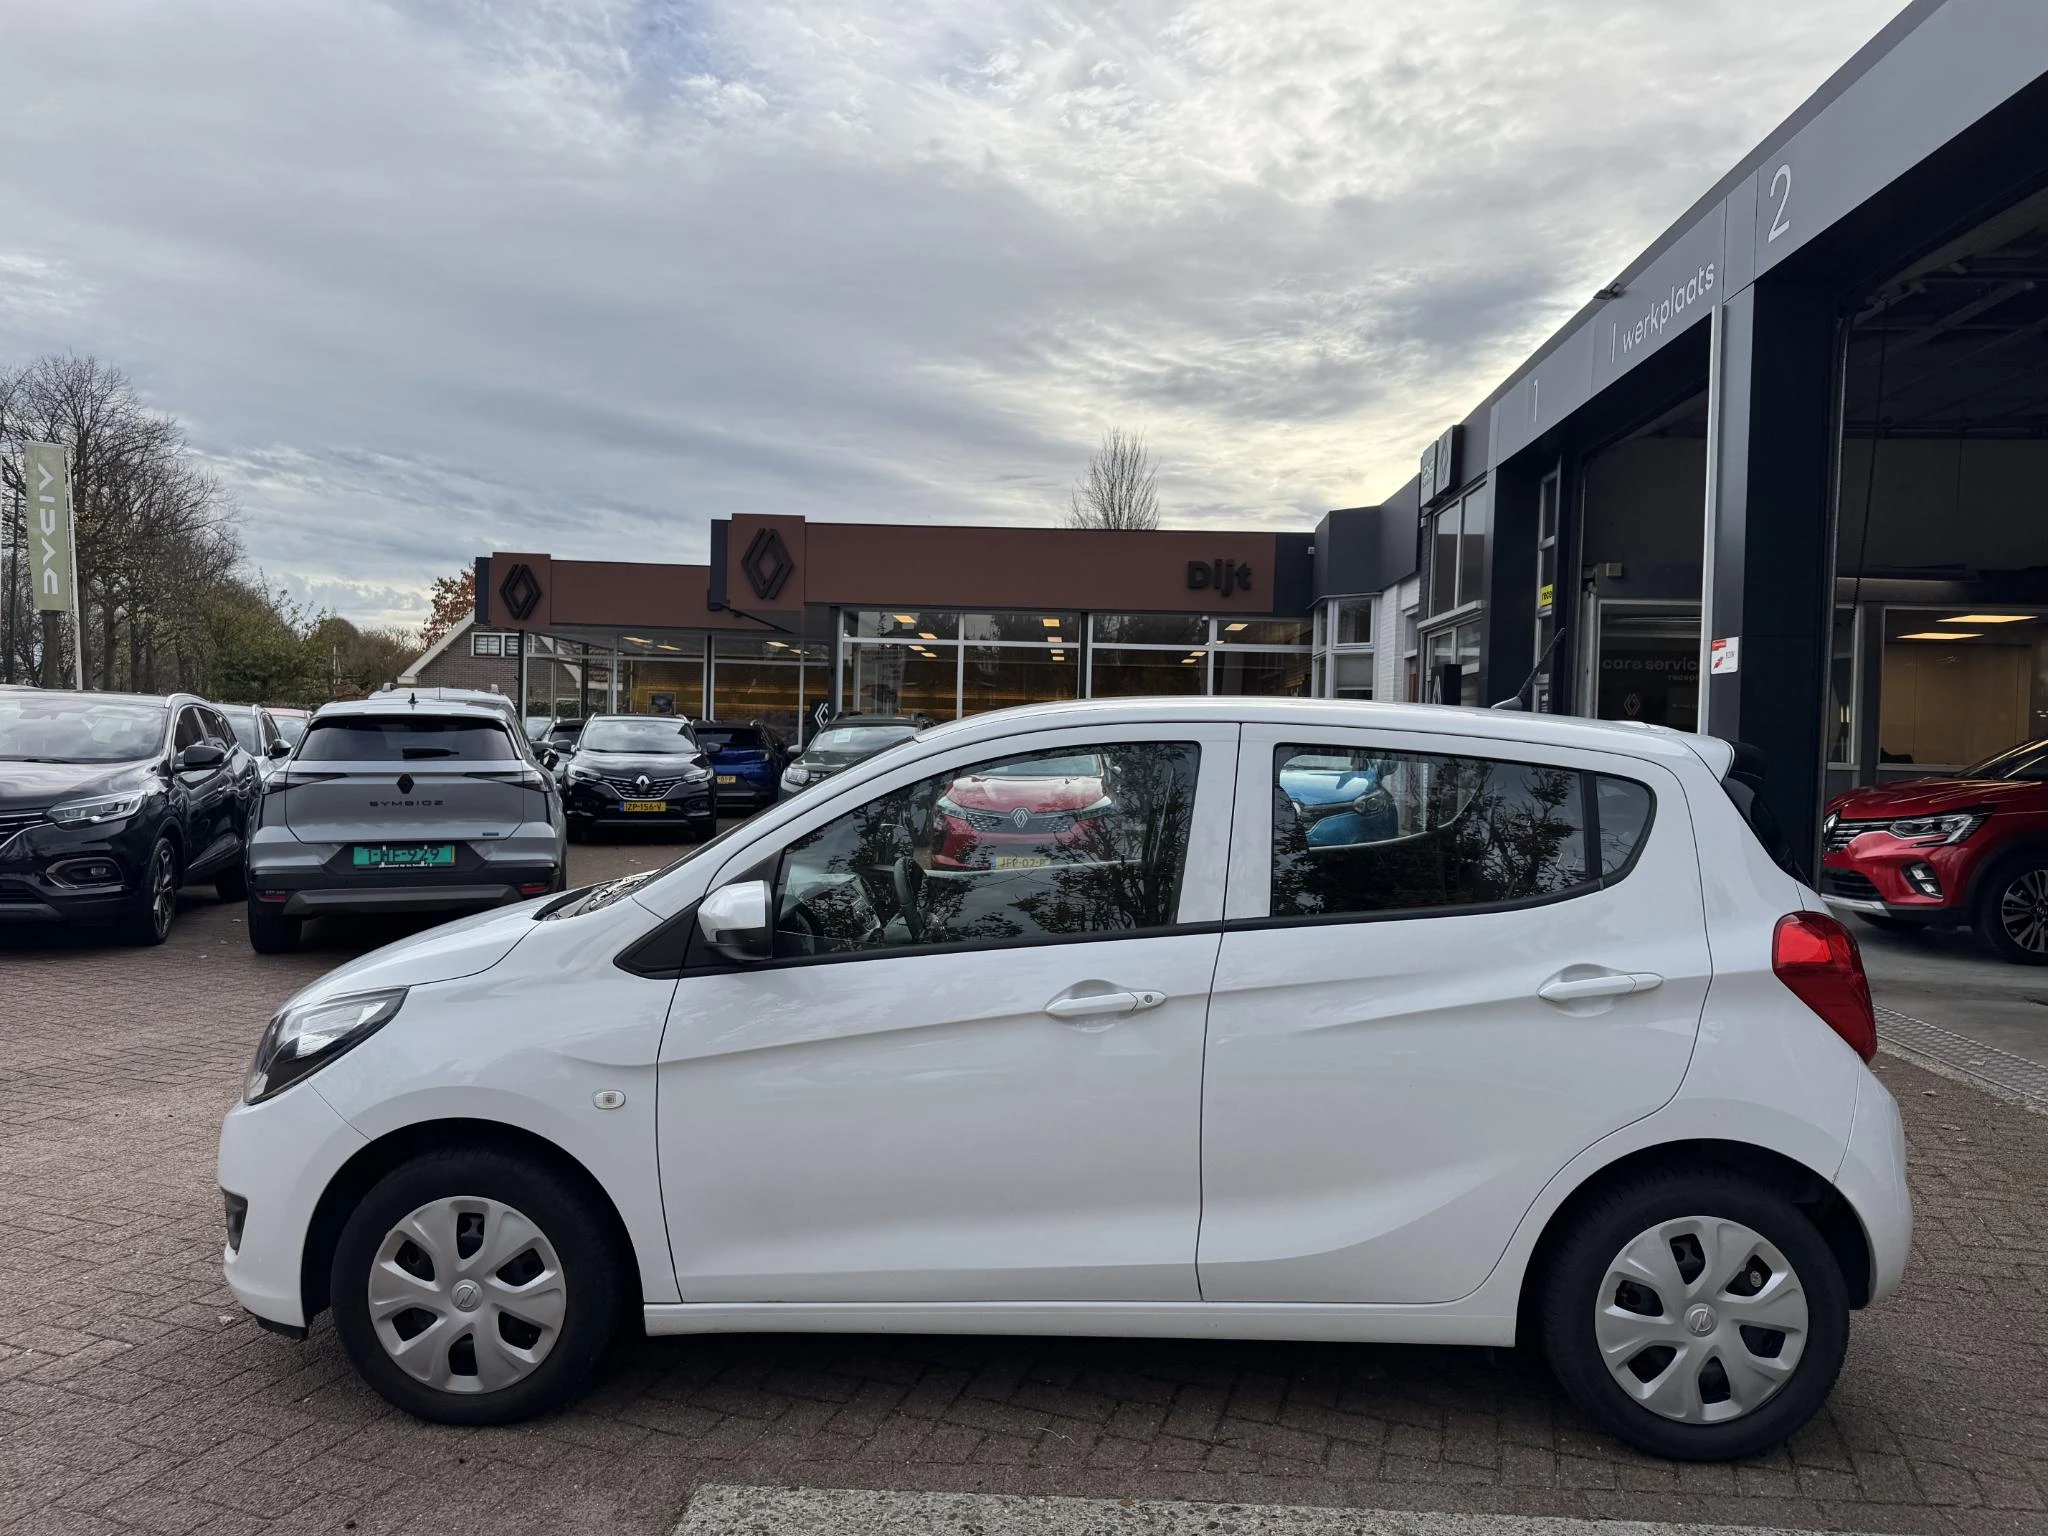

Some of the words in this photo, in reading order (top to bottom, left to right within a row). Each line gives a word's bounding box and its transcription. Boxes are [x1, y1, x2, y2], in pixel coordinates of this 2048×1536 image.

[1768, 164, 1792, 243] 2
[1622, 263, 1715, 352] werkplaats
[1533, 379, 1539, 422] 1
[1187, 558, 1252, 598] Dijt
[1602, 658, 1642, 670] care
[1645, 657, 1699, 671] servic
